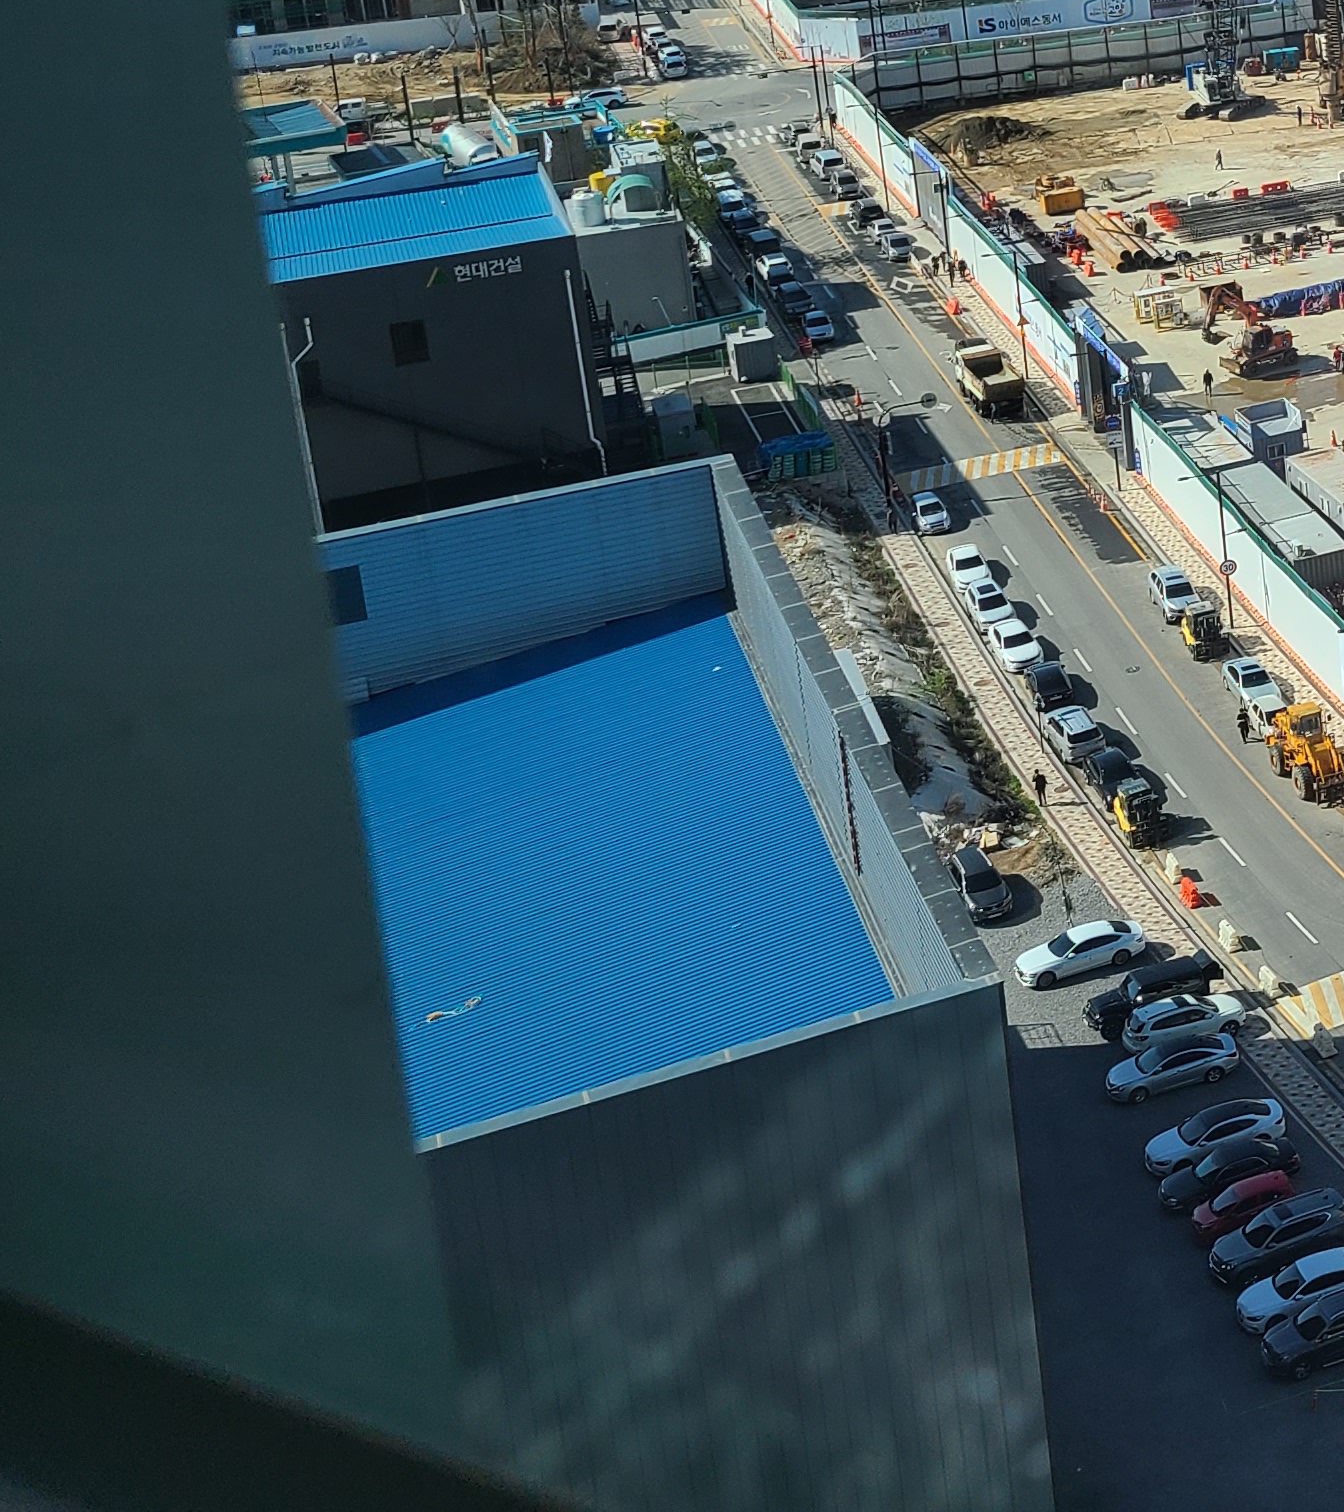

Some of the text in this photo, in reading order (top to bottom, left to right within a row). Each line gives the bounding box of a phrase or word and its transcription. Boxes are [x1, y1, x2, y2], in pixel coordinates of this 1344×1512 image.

[999, 13, 1062, 31] 아이에스동서
[453, 255, 523, 283] 현대건설
[1223, 563, 1234, 573] 30
